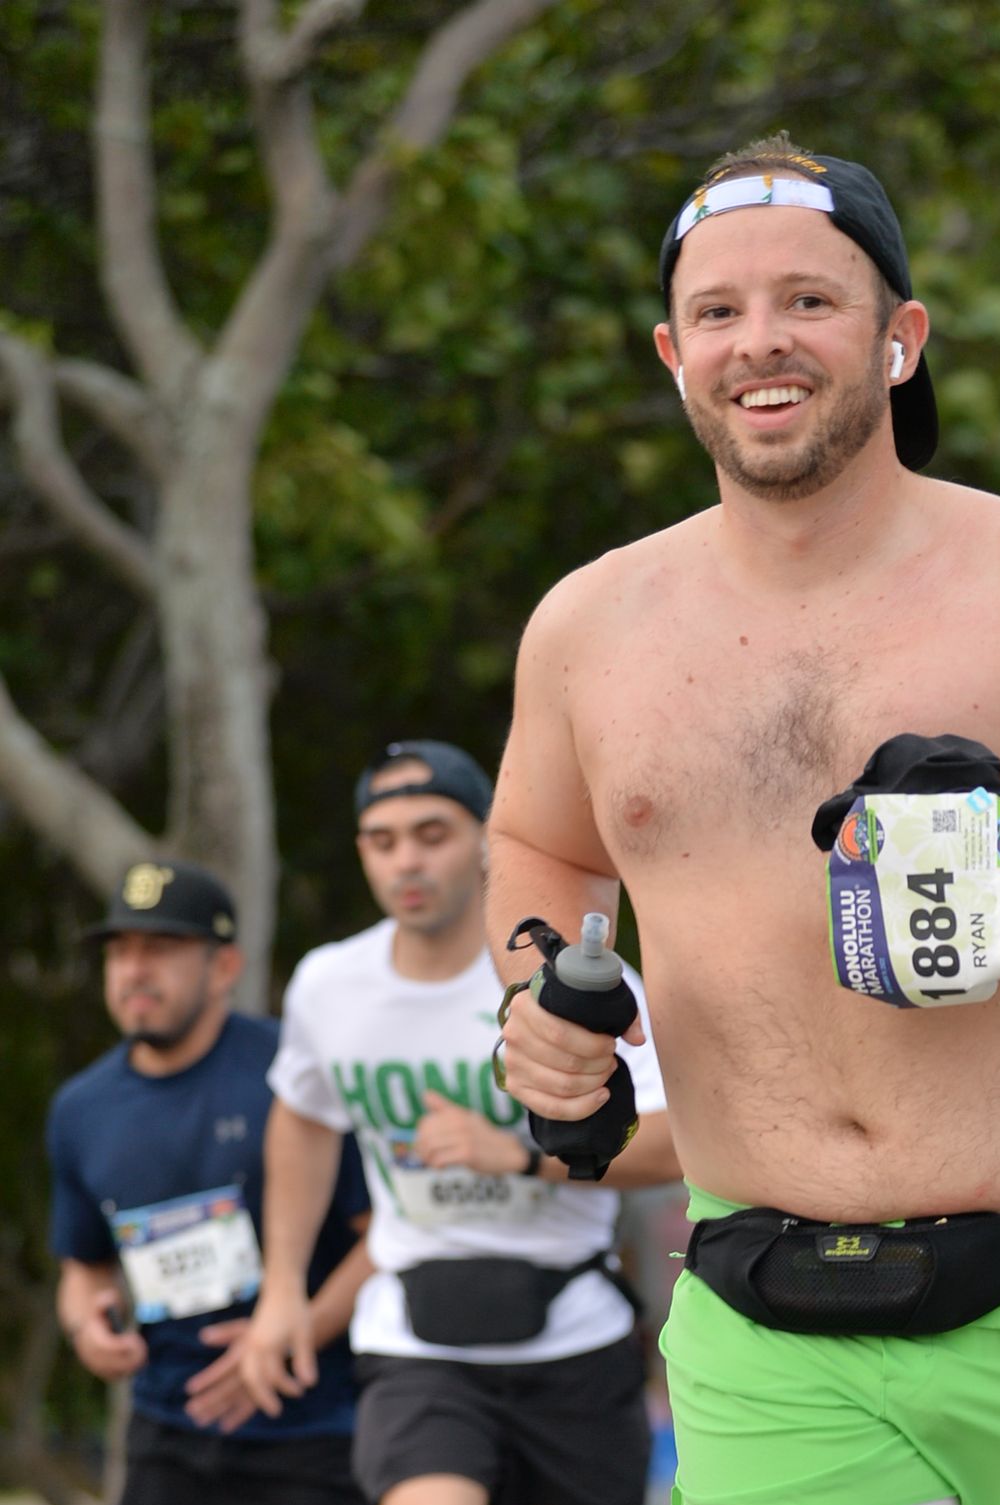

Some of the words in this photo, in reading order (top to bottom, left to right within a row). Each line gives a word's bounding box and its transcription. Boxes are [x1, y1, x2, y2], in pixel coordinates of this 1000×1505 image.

[840, 889, 868, 994] HONOLULU
[856, 889, 885, 995] MARATHON
[907, 867, 968, 1000] 1884
[970, 913, 989, 969] RYAN
